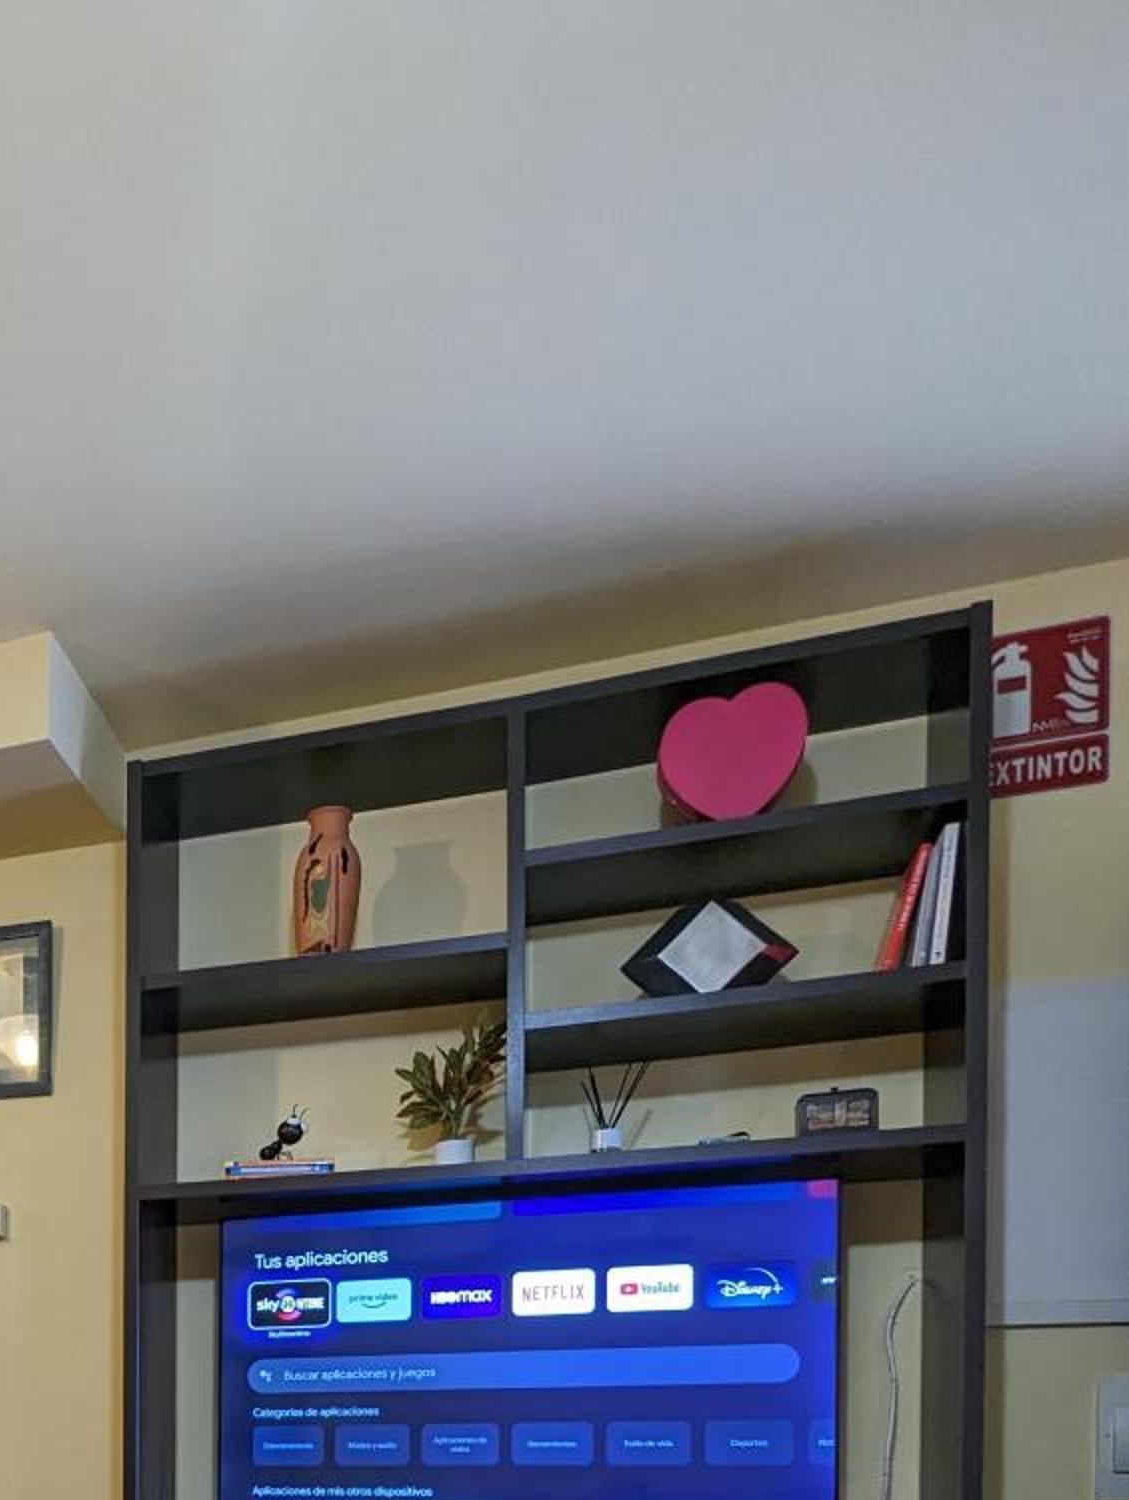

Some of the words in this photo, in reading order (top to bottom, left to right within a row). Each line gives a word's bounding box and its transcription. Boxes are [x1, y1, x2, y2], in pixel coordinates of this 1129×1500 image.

[255, 1253, 281, 1269] Tus
[285, 1249, 389, 1270] aplicaciones
[521, 1284, 584, 1302] NETFLIX
[640, 1282, 680, 1295] YouTube
[284, 1370, 318, 1382] Buscar
[321, 1368, 388, 1382] aplicaciones
[398, 1367, 436, 1382] juegos
[252, 1484, 311, 1498] Aplicaciones
[312, 1485, 325, 1497] de
[327, 1485, 345, 1497] mis
[346, 1486, 372, 1498] otros
[373, 1484, 434, 1498] dispositivos
